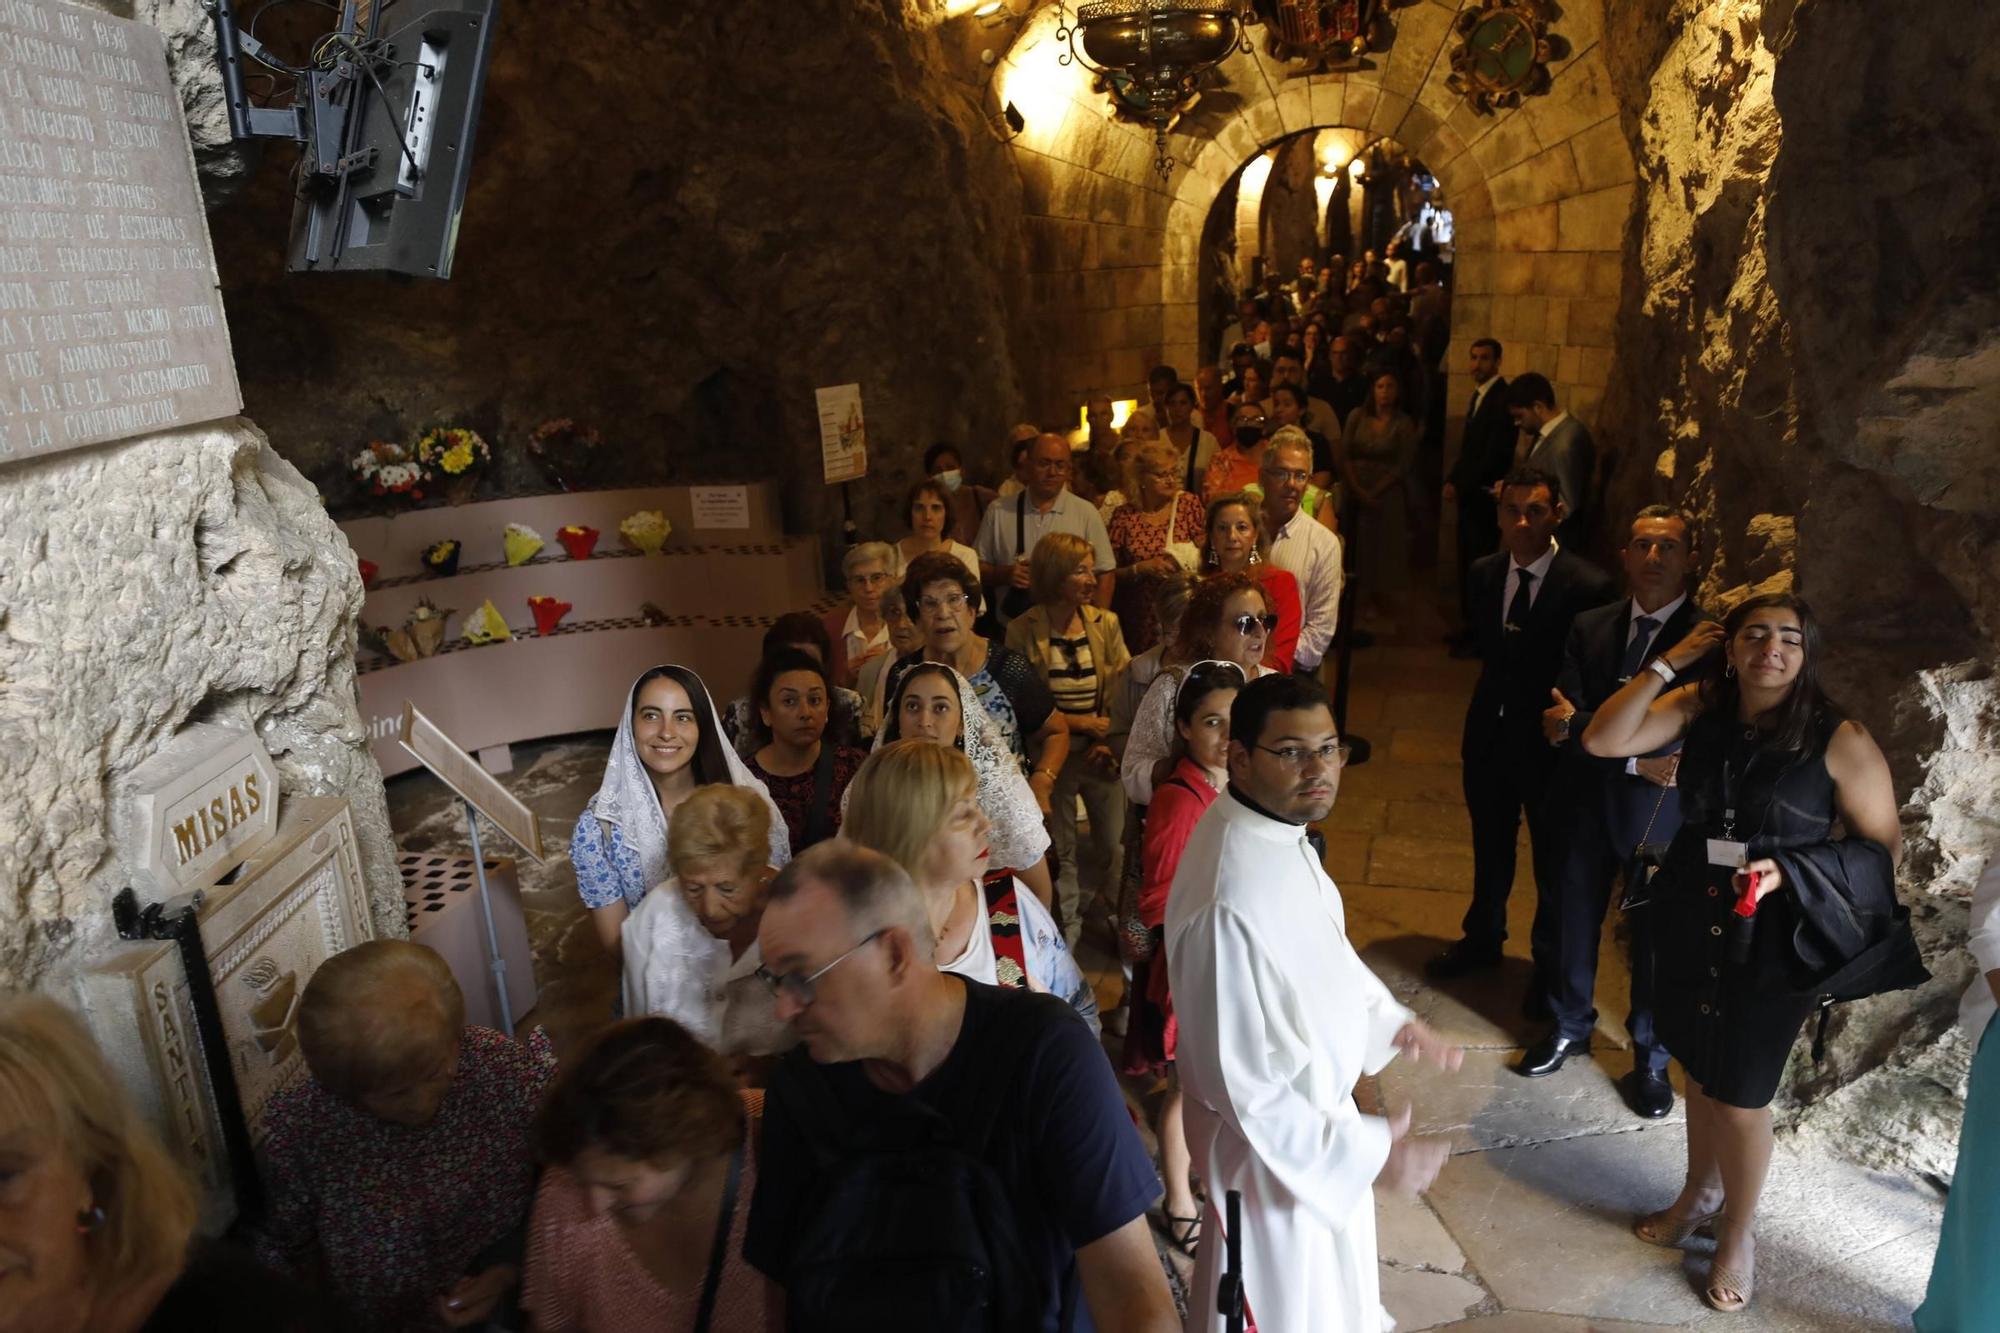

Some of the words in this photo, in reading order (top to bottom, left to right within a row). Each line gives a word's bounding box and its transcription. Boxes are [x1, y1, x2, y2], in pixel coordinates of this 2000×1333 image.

[60, 12, 84, 41] DE
[93, 19, 128, 51] 1858
[92, 51, 143, 85] CUEVA
[4, 68, 30, 98] LA
[38, 75, 88, 109] REINA
[95, 85, 118, 113] DE
[125, 91, 173, 121] ESPAÑA
[22, 106, 95, 142] AUGUSTO
[106, 119, 161, 149] ESPOSO
[58, 145, 81, 174] DE
[87, 177, 157, 210] SEÑORES
[86, 214, 110, 240] DE
[119, 214, 185, 241] ASTURIAS
[57, 247, 140, 273] FRANCISCA
[145, 248, 166, 272] DE
[50, 280, 75, 307] DE
[86, 273, 146, 305] ESPAÑA
[20, 316, 36, 343] Y
[41, 314, 67, 342] EN
[72, 311, 118, 339] ESTE
[124, 307, 171, 333] MISMO
[179, 304, 216, 329] SITIO
[59, 338, 171, 374] ADMINISTRADO
[86, 377, 110, 403] EL
[118, 363, 211, 399] SACRAMENTO
[25, 419, 53, 449] LA
[171, 773, 262, 866] MISAS
